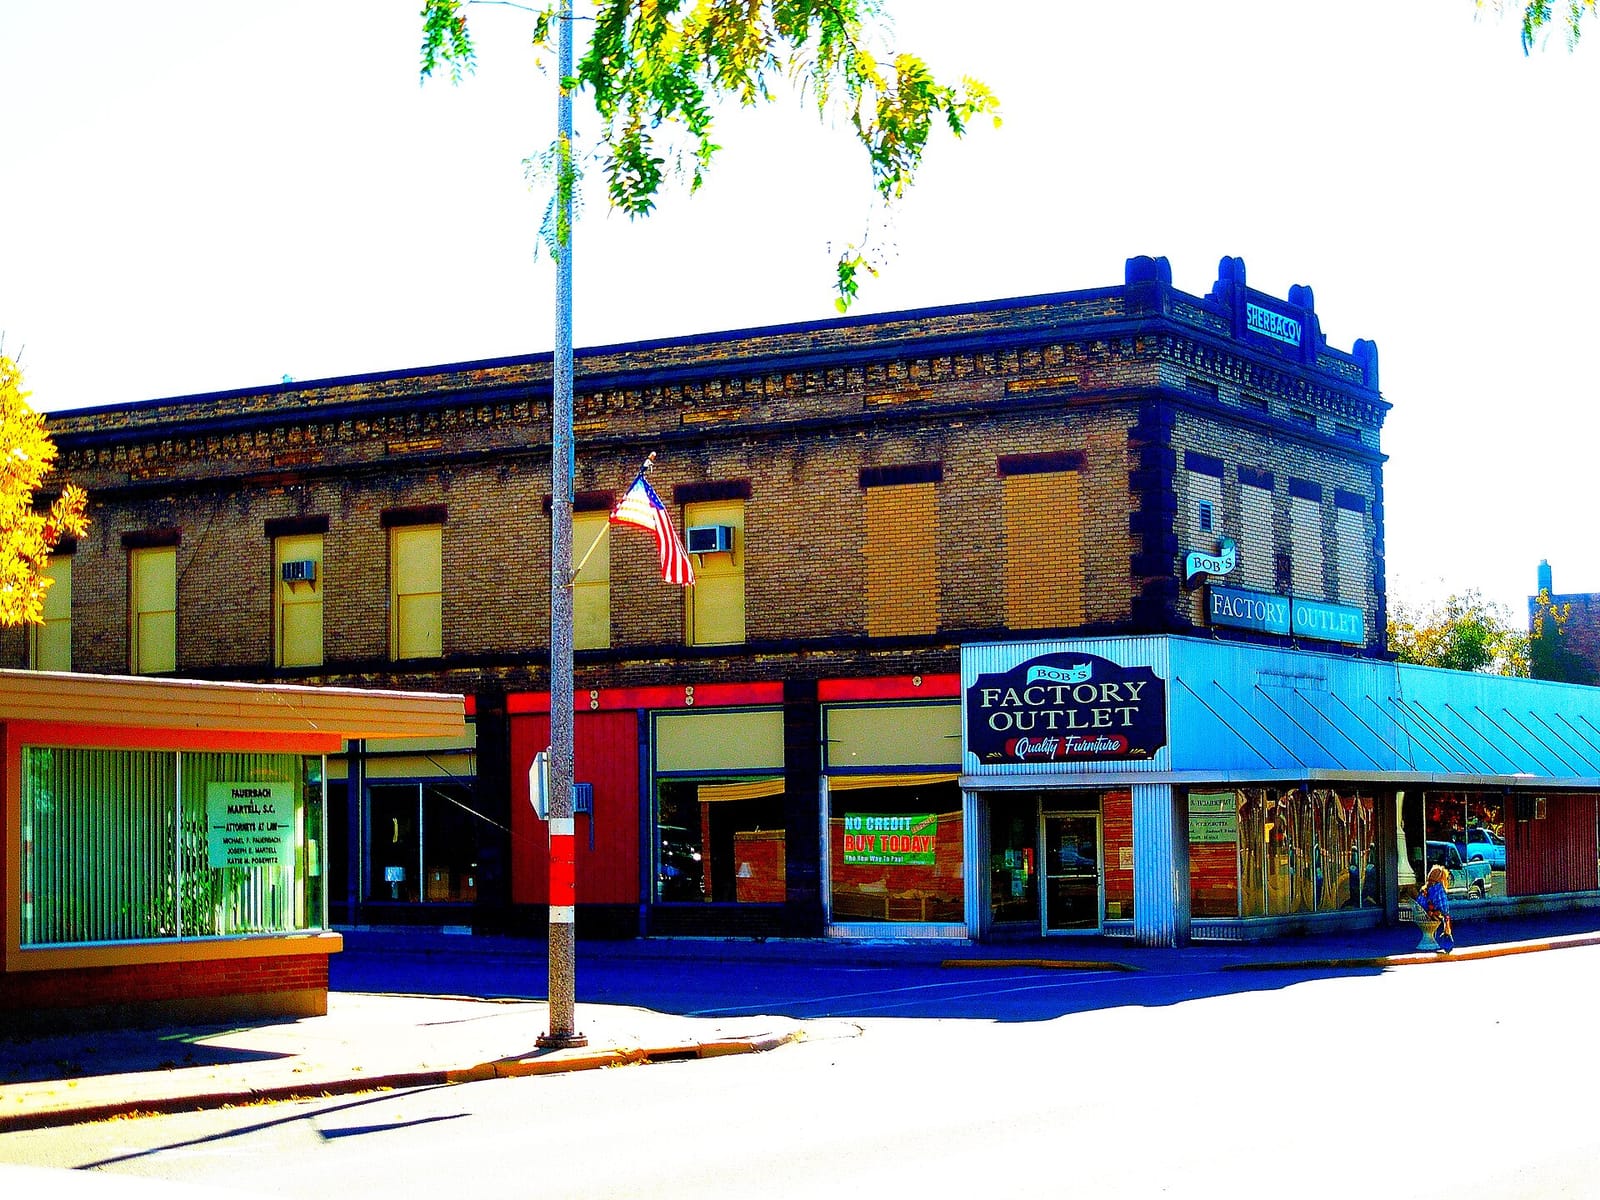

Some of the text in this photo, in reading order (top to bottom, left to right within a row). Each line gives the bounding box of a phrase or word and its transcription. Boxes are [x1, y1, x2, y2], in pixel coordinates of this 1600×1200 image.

[1193, 557, 1233, 572] BOB'S
[1213, 593, 1360, 634] FACTORY OUTLET
[1036, 668, 1087, 681] BOB'S
[980, 681, 1147, 708] FACTORY
[988, 706, 1139, 731] OUTLET
[1015, 734, 1121, 760] Quality Furniture
[845, 816, 862, 831] NO
[866, 816, 912, 831] CREDIT
[844, 834, 936, 853] BUY TODAY!
